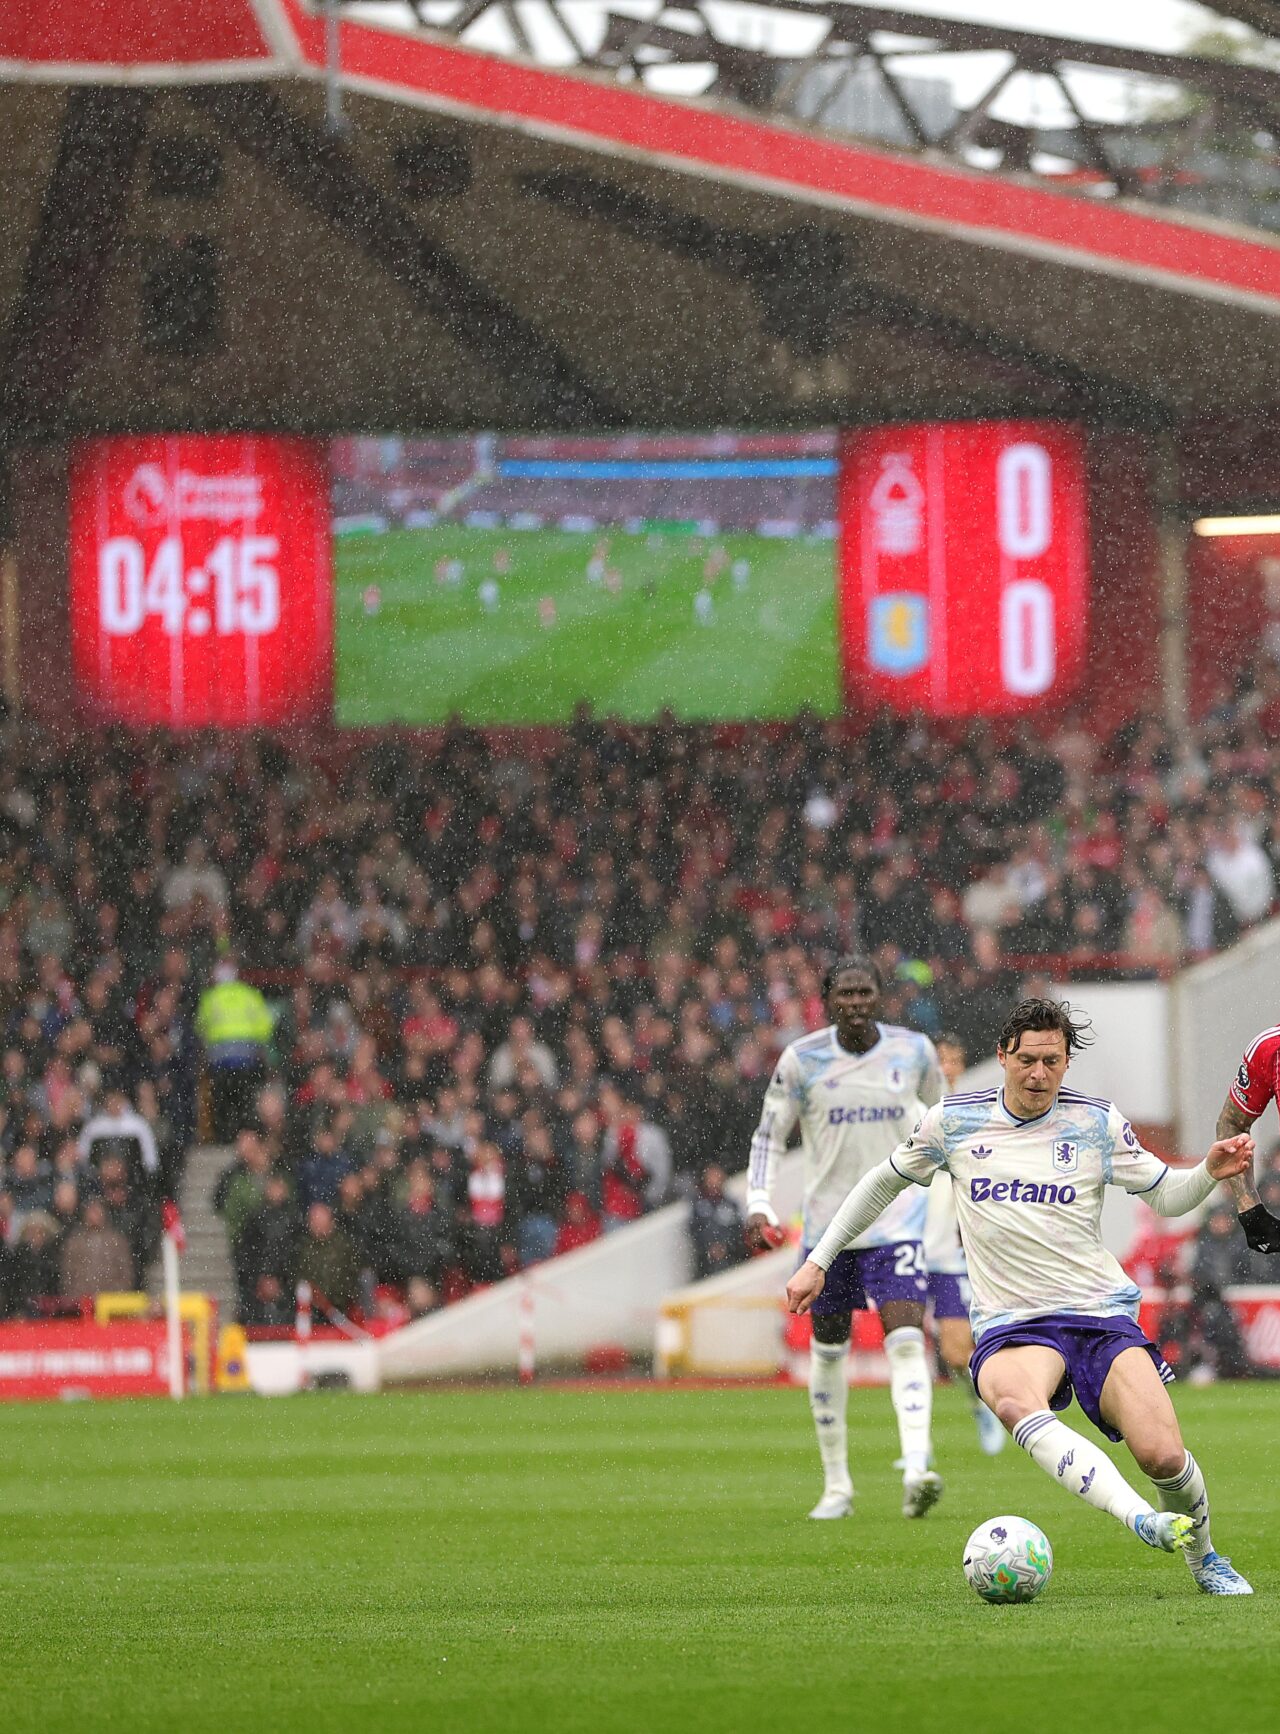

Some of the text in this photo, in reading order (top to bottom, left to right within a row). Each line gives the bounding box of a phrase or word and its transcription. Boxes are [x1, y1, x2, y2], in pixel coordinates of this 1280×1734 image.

[997, 441, 1052, 559] 0
[101, 536, 280, 636] 04:15
[1002, 578, 1055, 696] 0
[828, 1104, 905, 1125] Betano
[971, 1178, 1076, 1204] Betano
